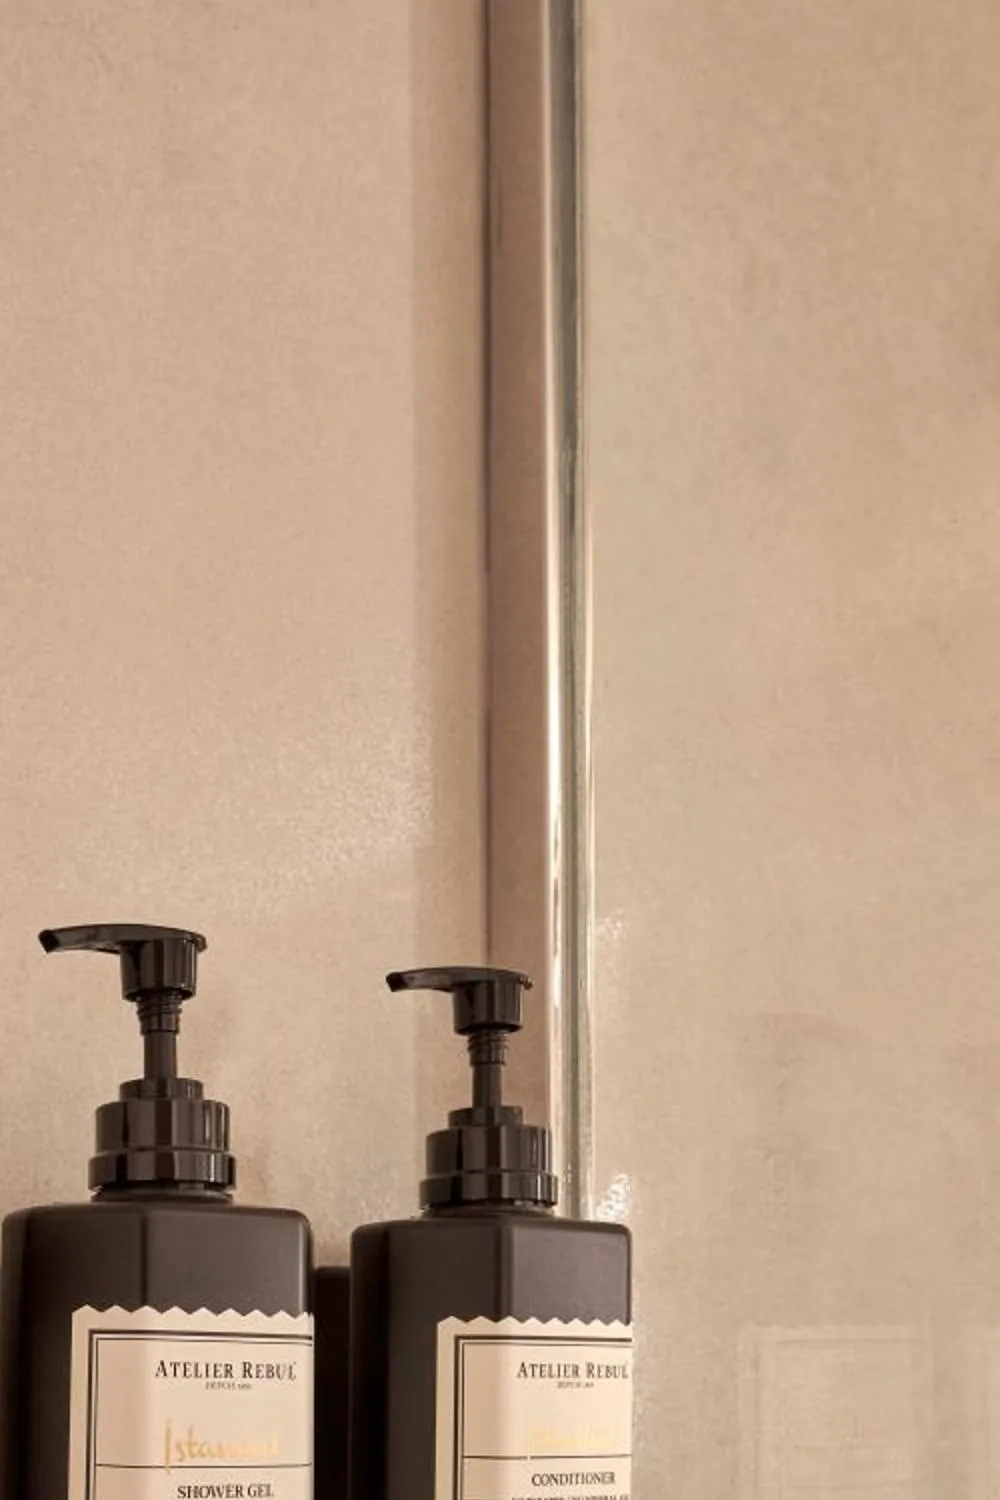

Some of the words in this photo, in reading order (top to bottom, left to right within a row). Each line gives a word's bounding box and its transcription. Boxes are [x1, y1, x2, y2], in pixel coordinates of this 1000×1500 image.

[155, 1360, 234, 1380] ATELIER
[242, 1361, 297, 1381] REBUL
[517, 1361, 580, 1379] ATELIER
[586, 1362, 629, 1379] REBUL
[531, 1471, 616, 1487] CONDITIONER
[177, 1484, 244, 1500] SHOWER
[247, 1483, 274, 1499] GEL
